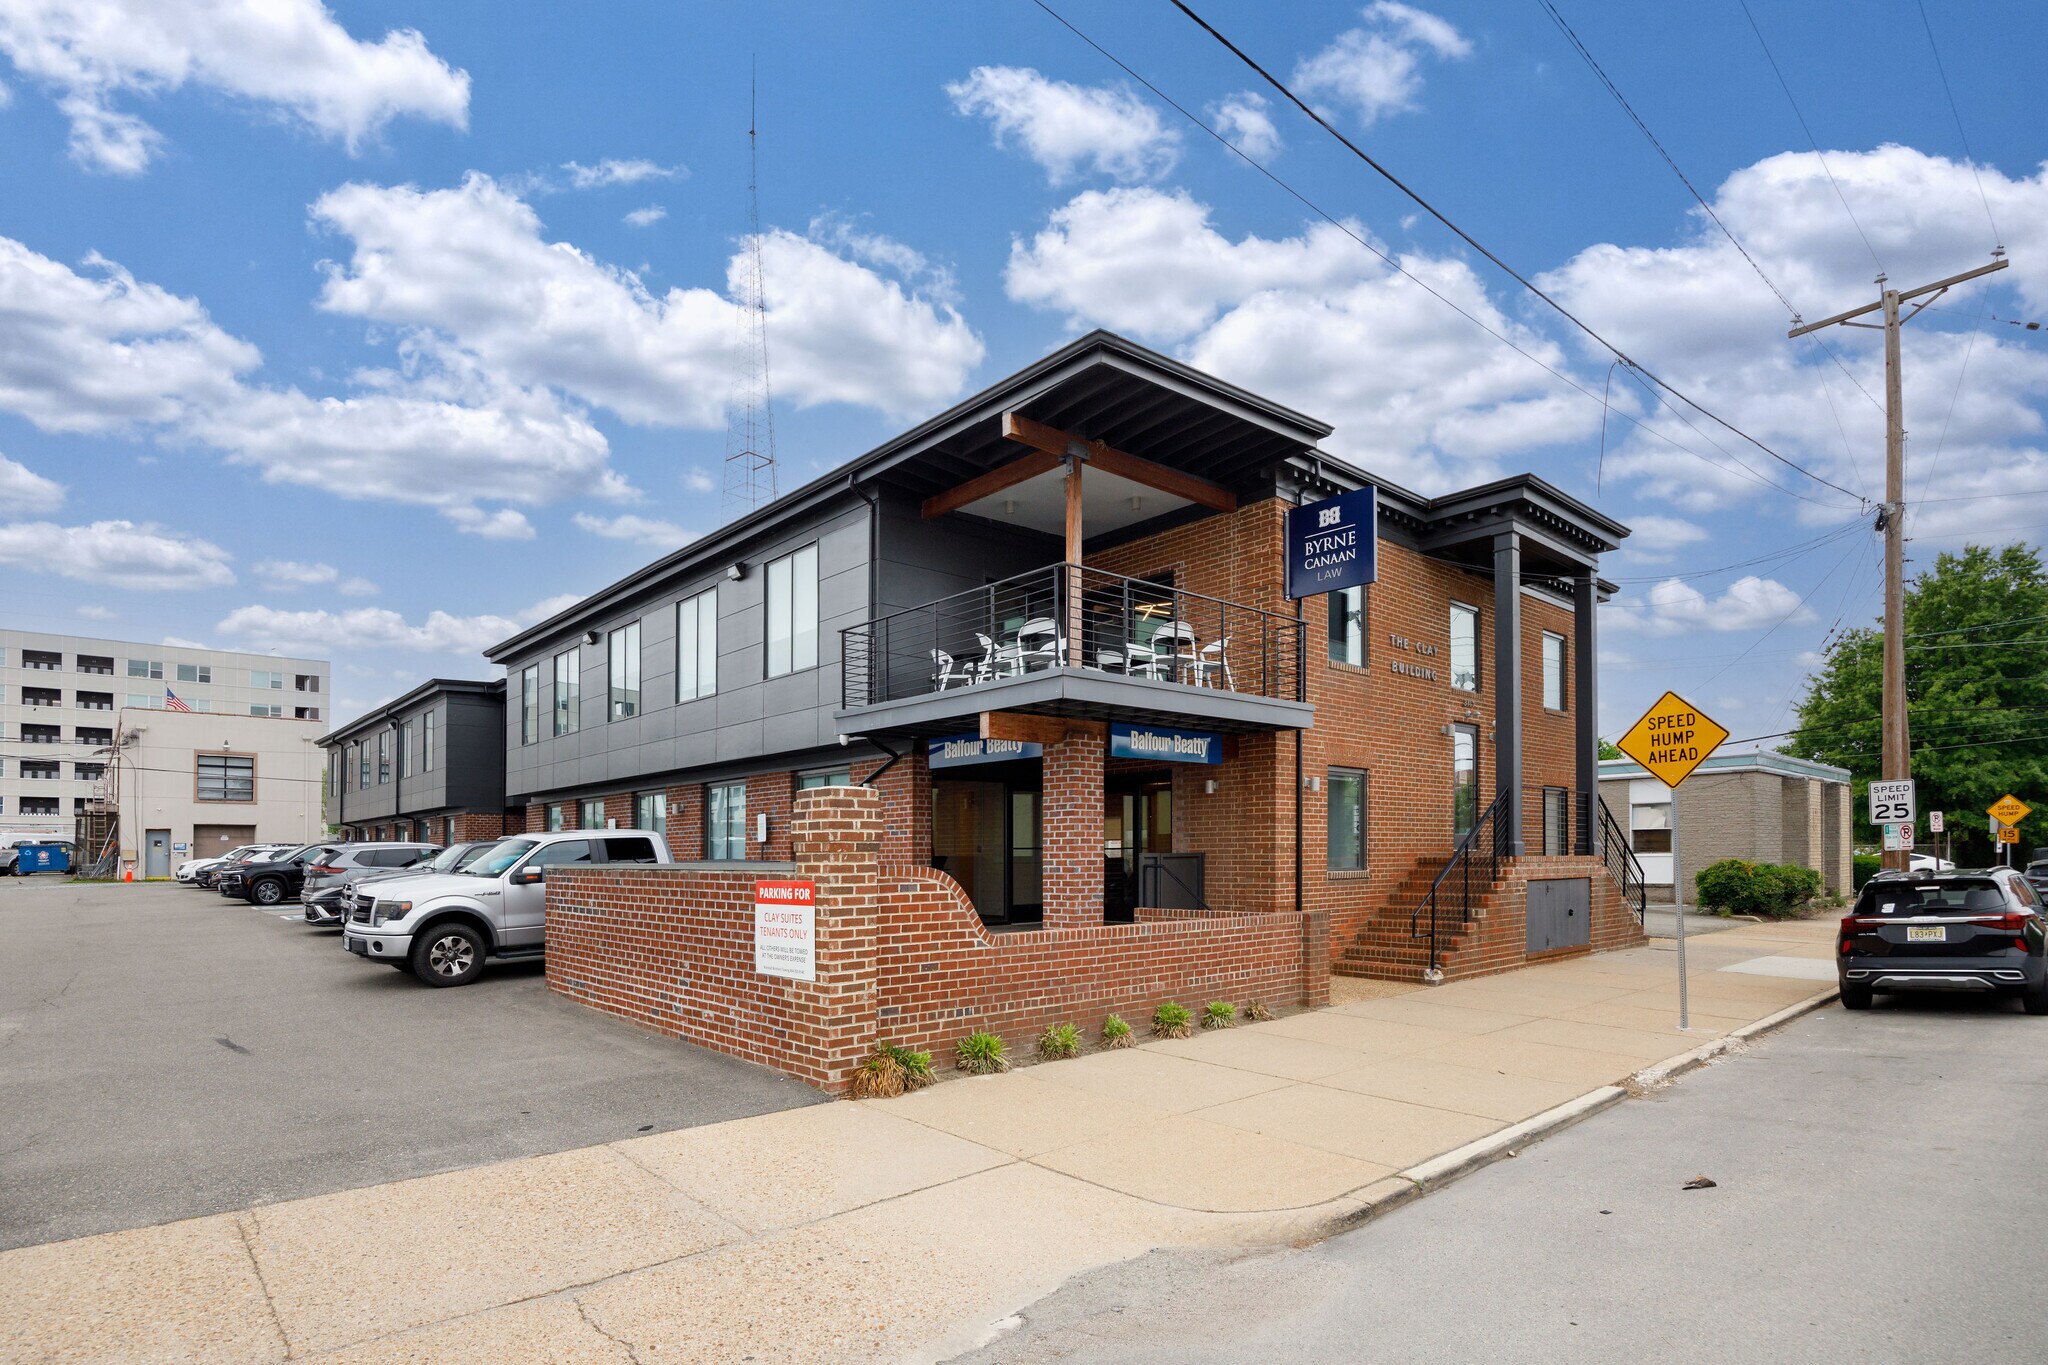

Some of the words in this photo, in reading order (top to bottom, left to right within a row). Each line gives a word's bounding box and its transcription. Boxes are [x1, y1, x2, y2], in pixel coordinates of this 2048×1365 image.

[1305, 531, 1356, 557] BYRNE
[1304, 548, 1356, 570] CANAAN
[1317, 567, 1343, 581] LAW
[1389, 634, 1409, 650] THE
[1415, 641, 1439, 657] CLAY
[1391, 660, 1437, 681] BUILDING
[1648, 713, 1696, 731] SPEED
[1130, 730, 1172, 752] Balfour
[1174, 734, 1208, 758] Beatty
[1651, 730, 1695, 747] HUMP
[944, 739, 984, 759] Balfour
[1648, 747, 1698, 764] AHEAD
[1873, 784, 1910, 794] SPEED
[1877, 793, 1906, 802] LIMIT
[1874, 802, 1910, 820] 25
[2003, 830, 2016, 838] 15
[759, 887, 793, 900] PARKING
[794, 888, 811, 901] FOR
[764, 912, 780, 923] CLAY
[780, 913, 803, 925] SUITES
[760, 926, 788, 939] TENANTS
[789, 929, 808, 940] ONLY
